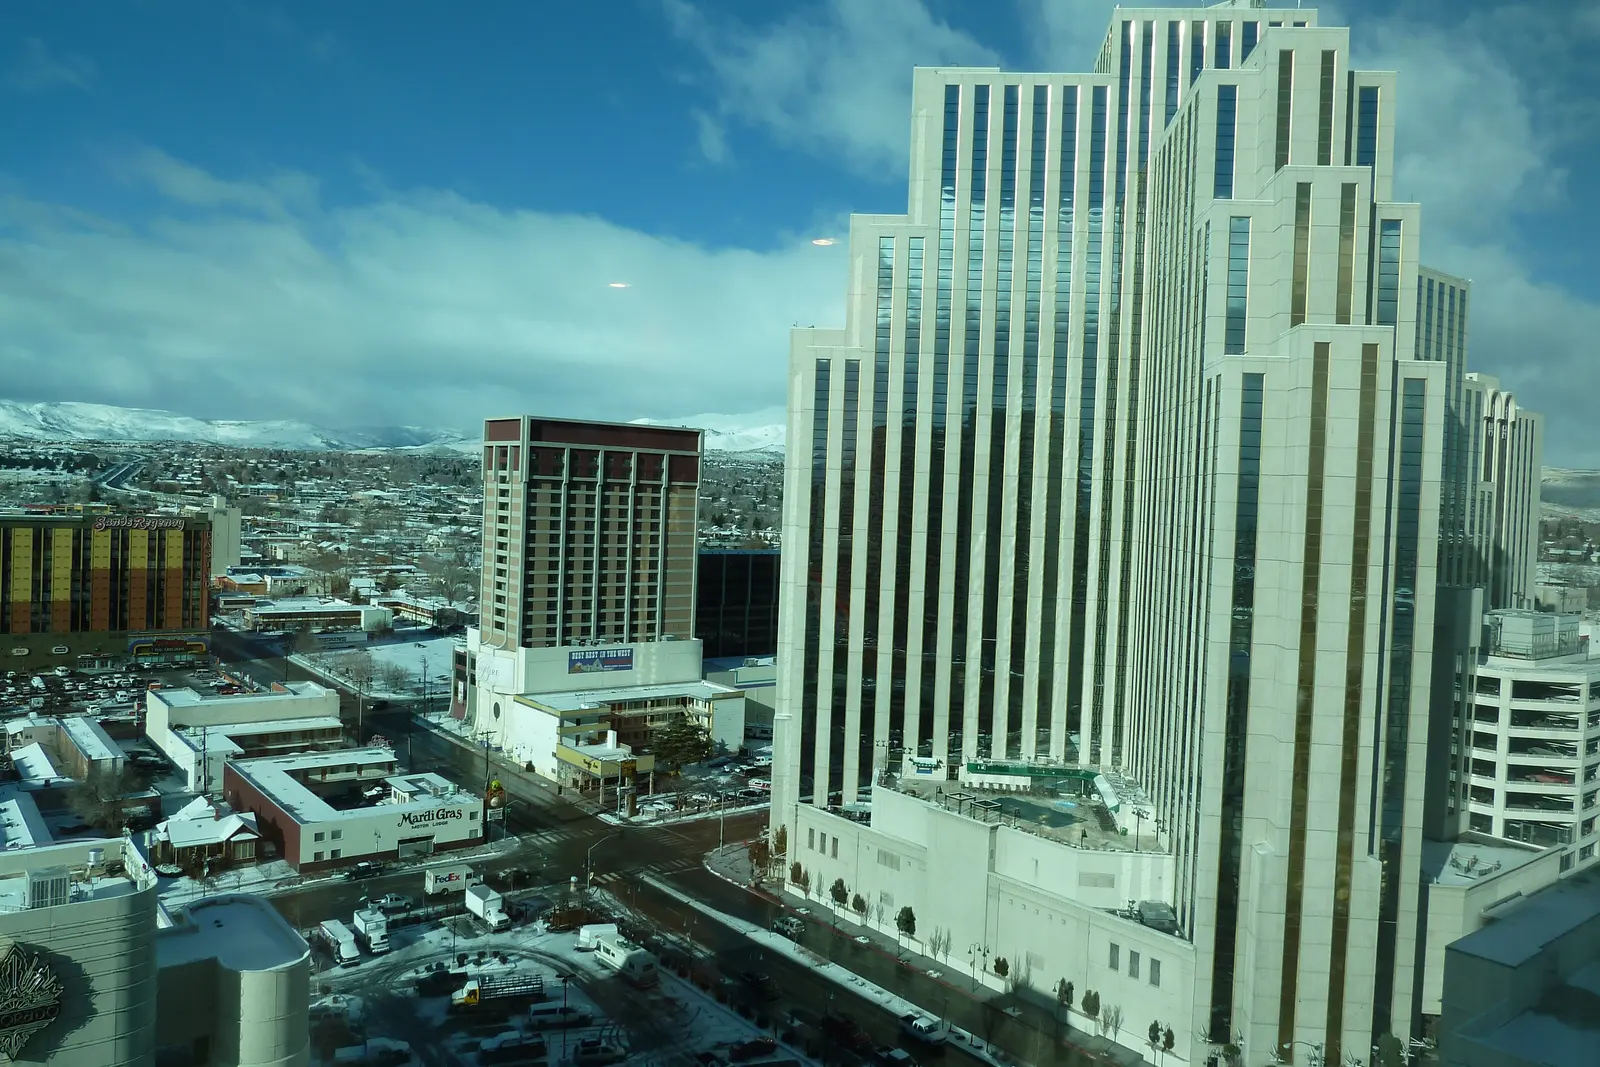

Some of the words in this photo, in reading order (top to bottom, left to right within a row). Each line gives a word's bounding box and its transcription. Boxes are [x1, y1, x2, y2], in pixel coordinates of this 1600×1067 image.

[92, 515, 133, 531] Sands
[132, 517, 185, 531] Regency
[572, 651, 585, 660] BEST
[585, 650, 598, 659] REST
[599, 650, 606, 658] IN
[606, 650, 616, 658] THE
[617, 649, 631, 657] WEST
[397, 810, 435, 827] Mardi
[436, 808, 463, 819] Gras
[434, 872, 461, 883] FedEx
